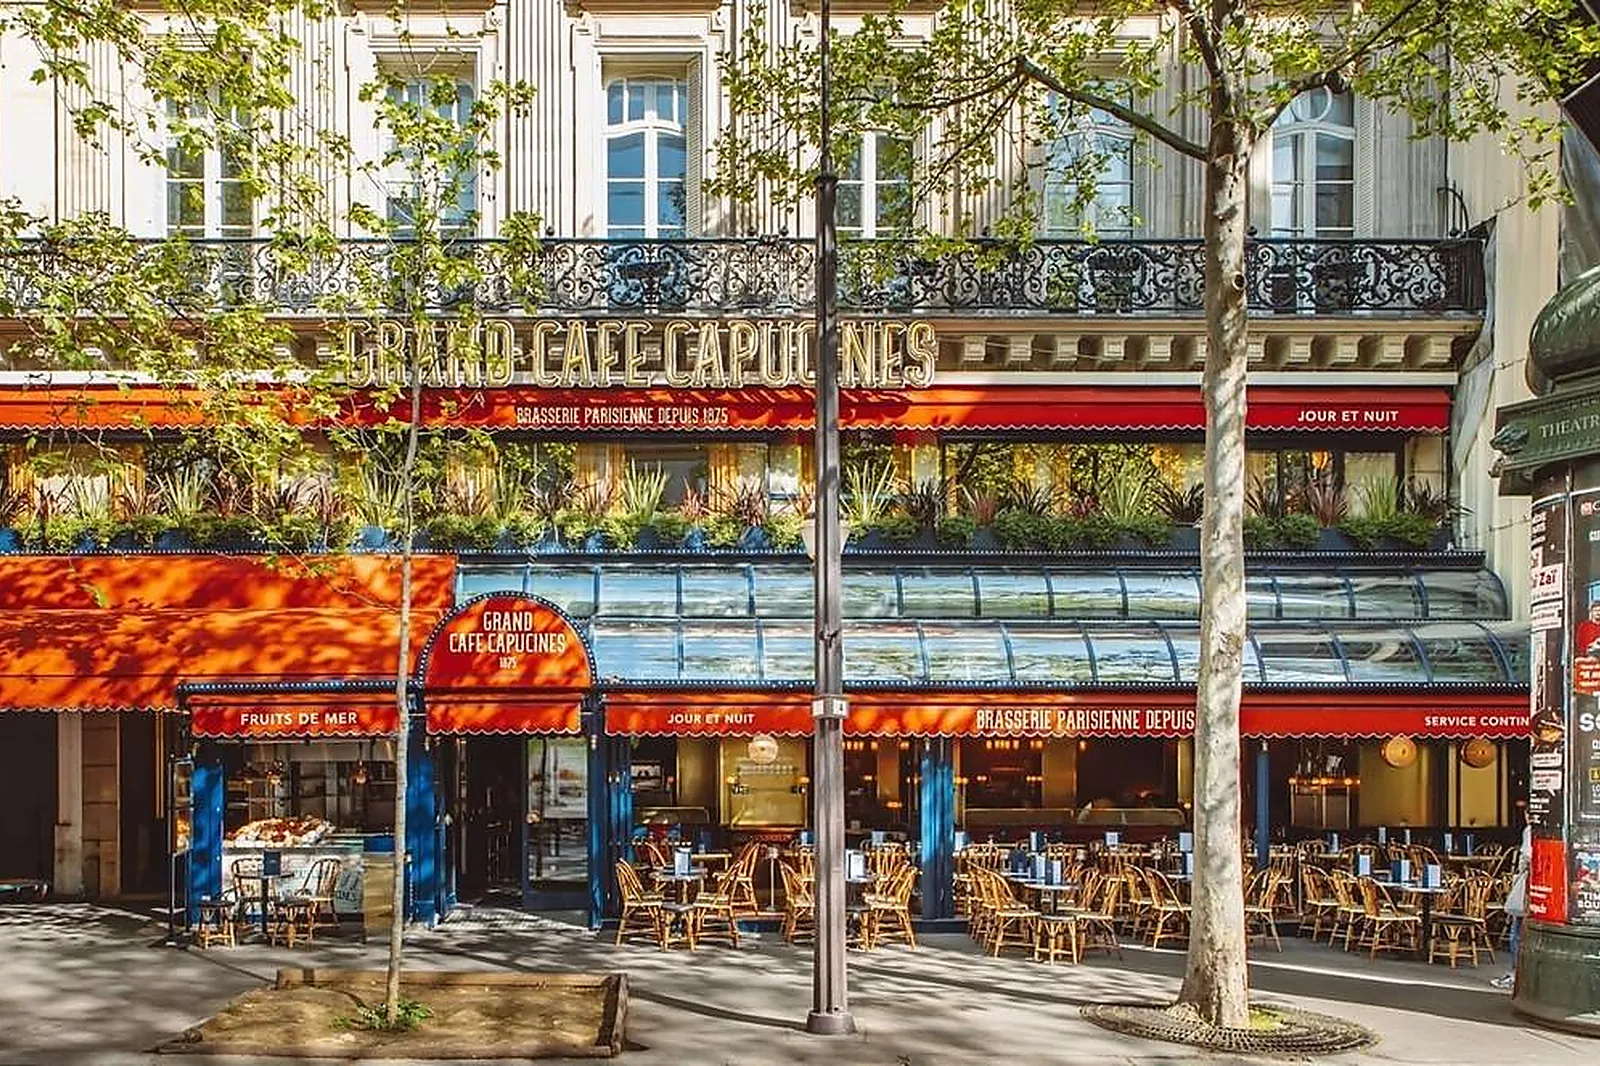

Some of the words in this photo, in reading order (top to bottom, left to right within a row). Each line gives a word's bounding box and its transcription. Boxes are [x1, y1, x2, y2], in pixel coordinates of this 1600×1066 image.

[346, 319, 515, 388] GRAND
[534, 319, 653, 388] CAFE
[664, 319, 938, 388] CAPUCNES
[516, 407, 580, 424] BRASSERIE
[584, 407, 654, 424] PARISIENNE
[658, 407, 699, 424] DEPUIS
[703, 407, 729, 424] 1875
[1298, 410, 1337, 422] JOUR
[1341, 410, 1359, 422] ET
[1363, 410, 1399, 422] NUIT
[483, 611, 533, 631] GRAND
[449, 633, 484, 653] CAFE
[487, 633, 566, 653] CAPUCINES
[240, 713, 293, 725] FRUITS
[298, 712, 319, 725] DE
[324, 712, 358, 724] MER
[667, 713, 702, 724] JOUR
[705, 713, 720, 724] ET
[724, 713, 755, 724] NUIT
[976, 709, 1051, 730] BRASSERIE
[1057, 709, 1140, 730] PARISIENNE
[1145, 709, 1196, 730] DEPUIS
[1424, 716, 1477, 727] SERVICE
